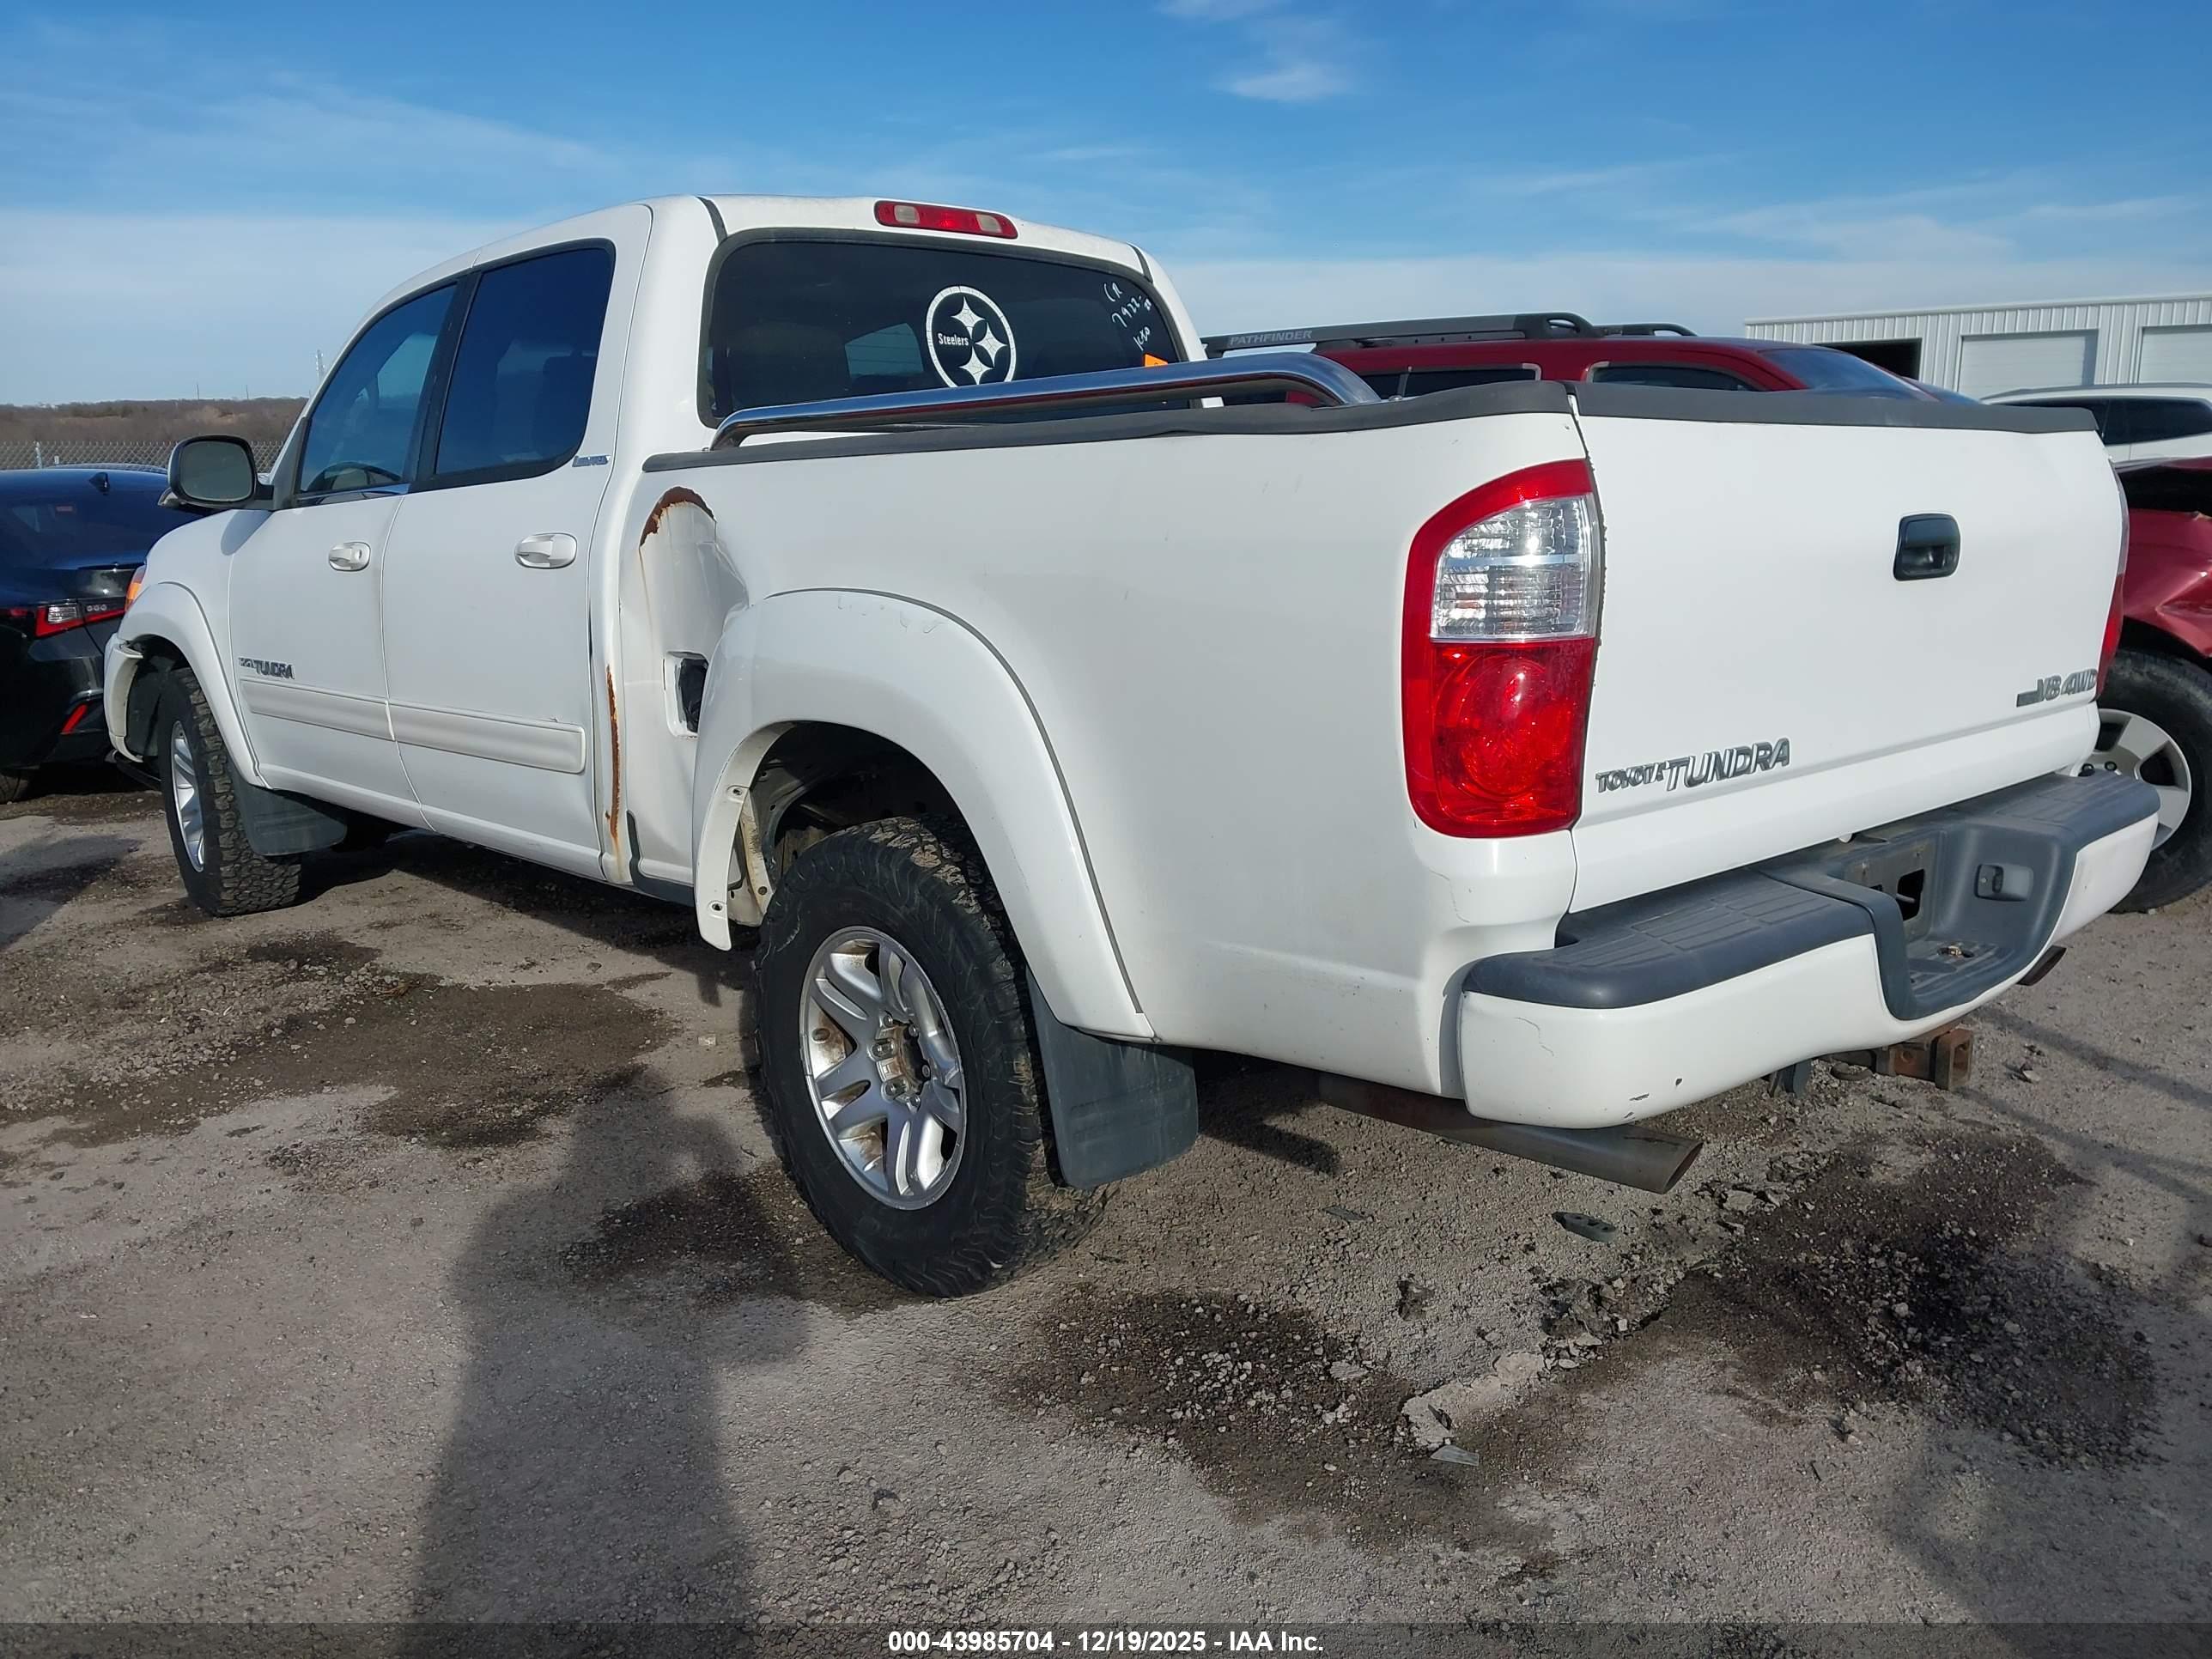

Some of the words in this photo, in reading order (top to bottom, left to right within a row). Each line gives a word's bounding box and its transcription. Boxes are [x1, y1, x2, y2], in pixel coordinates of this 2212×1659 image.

[937, 332, 969, 346] Steelers
[1229, 330, 1313, 346] PATHFINDER
[2061, 669, 2098, 696] 4WD
[1595, 762, 1667, 793] TOYOTA
[1665, 737, 1791, 792] TUNDRA
